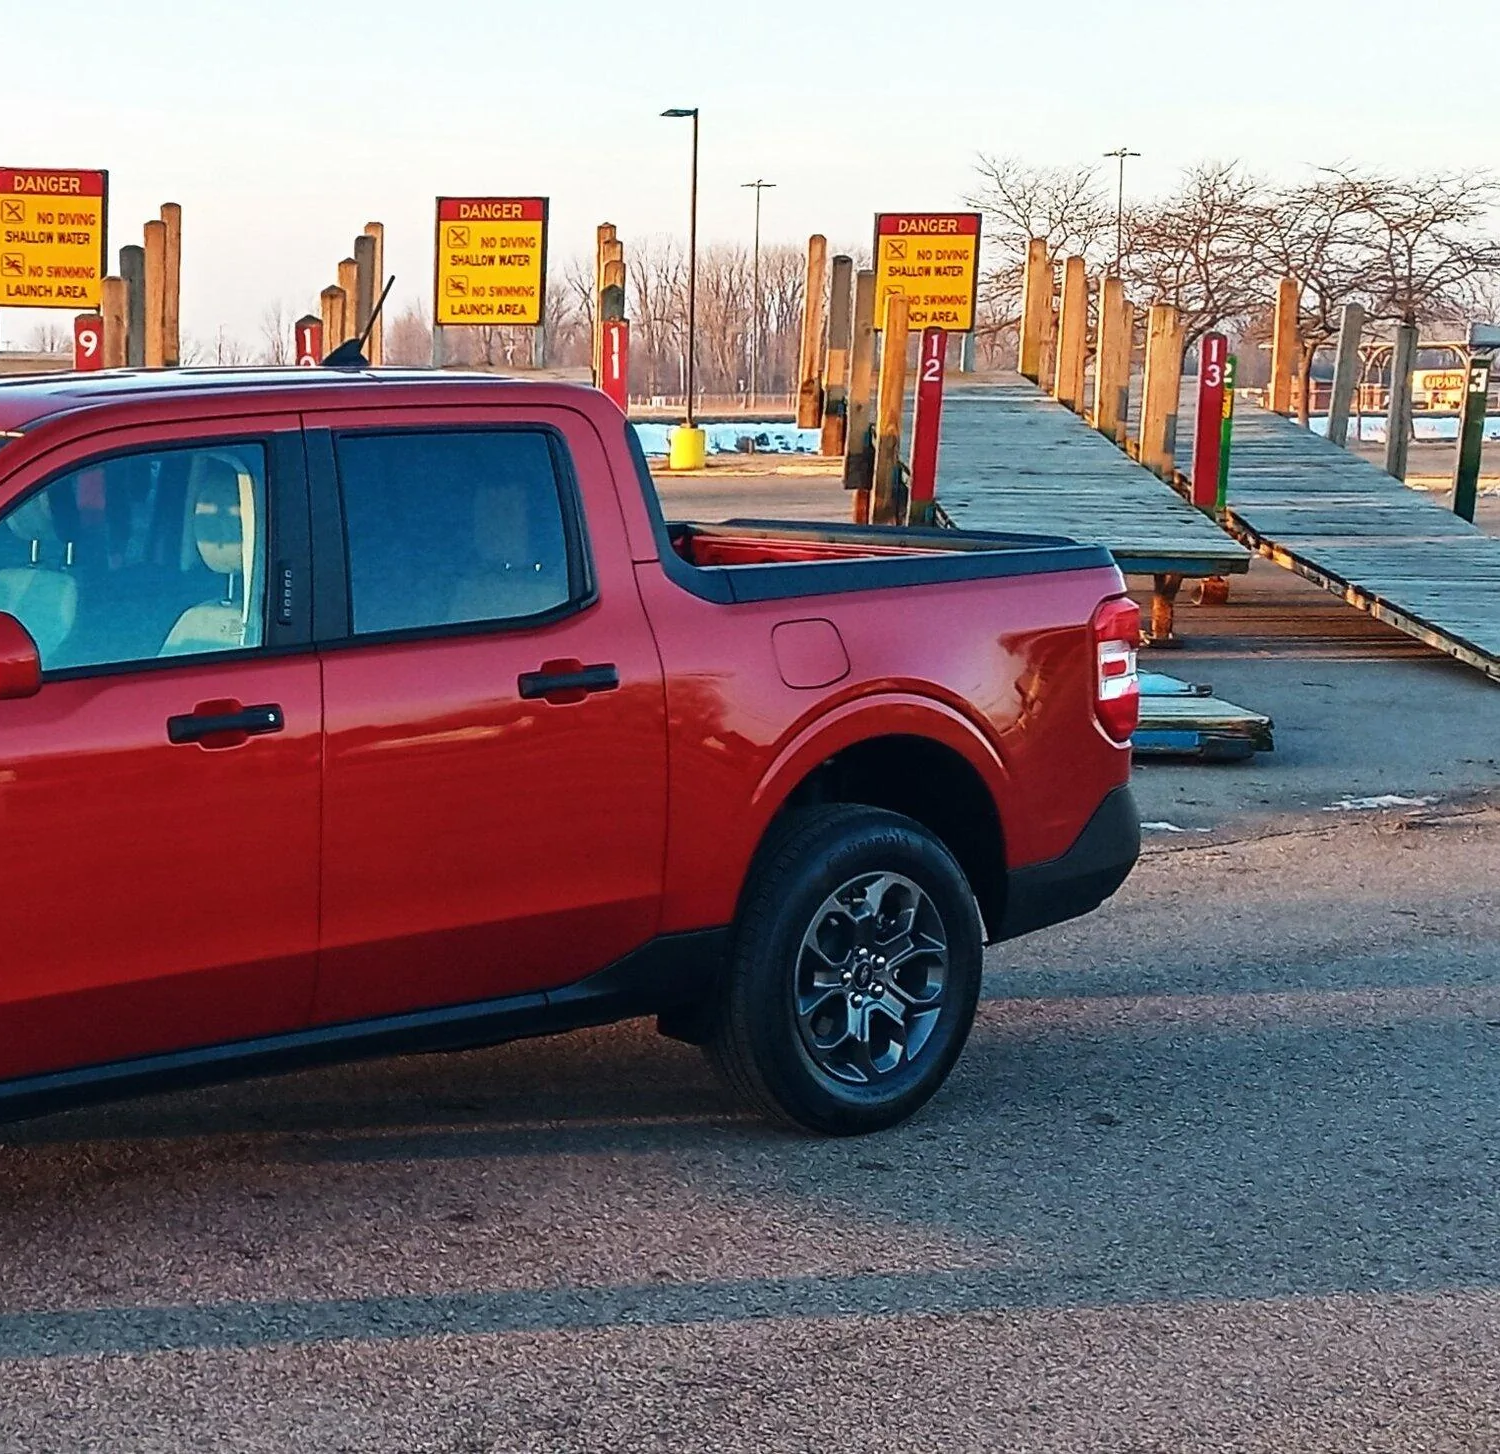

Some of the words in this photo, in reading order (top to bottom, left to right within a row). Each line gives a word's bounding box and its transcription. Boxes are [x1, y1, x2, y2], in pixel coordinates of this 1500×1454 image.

[13, 175, 81, 194] DANGER
[459, 203, 523, 219] DANGER
[36, 212, 54, 225] NO
[57, 212, 96, 226] DIVING
[898, 219, 957, 233] DANGER
[4, 230, 54, 244] SHALLOW
[57, 231, 90, 245] WATER
[480, 236, 497, 249] NO
[500, 236, 537, 249] DIVING
[450, 254, 496, 267] SHALLOW
[499, 254, 530, 266] WATER
[916, 249, 932, 261] NO
[935, 249, 969, 261] DIVING
[28, 265, 43, 278] NO
[46, 265, 95, 279] SWIMMING
[888, 265, 931, 277] SHALLOW
[934, 265, 964, 277] WATER
[6, 284, 52, 298] LAUNCH
[55, 285, 88, 299] AREA
[471, 286, 486, 297] NO
[489, 286, 535, 298] SWIMMING
[923, 294, 968, 306] SWIMMING
[450, 303, 494, 316] LAUNCH
[496, 303, 527, 315] AREA
[931, 311, 959, 323] AREA
[78, 329, 98, 358] 9
[610, 326, 620, 380] 11
[922, 333, 941, 382] 12
[1204, 339, 1221, 388] 13
[1468, 367, 1489, 393] 3
